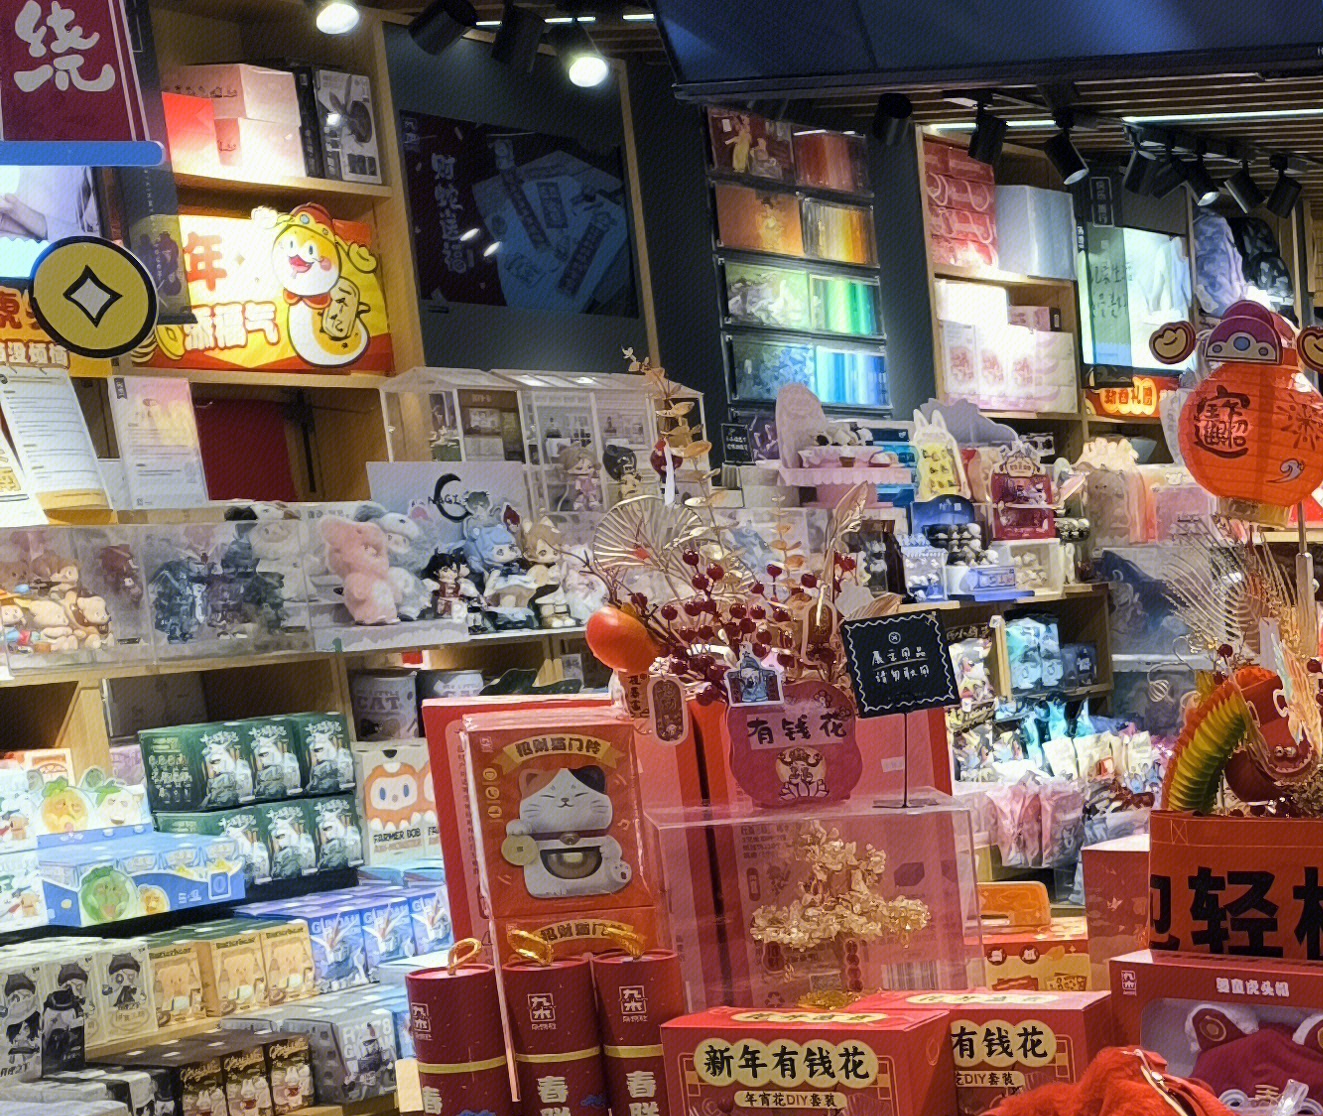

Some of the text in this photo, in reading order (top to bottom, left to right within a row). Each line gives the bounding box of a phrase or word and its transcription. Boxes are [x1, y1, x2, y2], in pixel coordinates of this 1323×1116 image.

[748, 711, 847, 745] 有钱花
[952, 1026, 1048, 1059] 有钱花
[703, 1045, 870, 1080] 新年有钱花
[744, 1091, 838, 1108] 年宵花DIY套装
